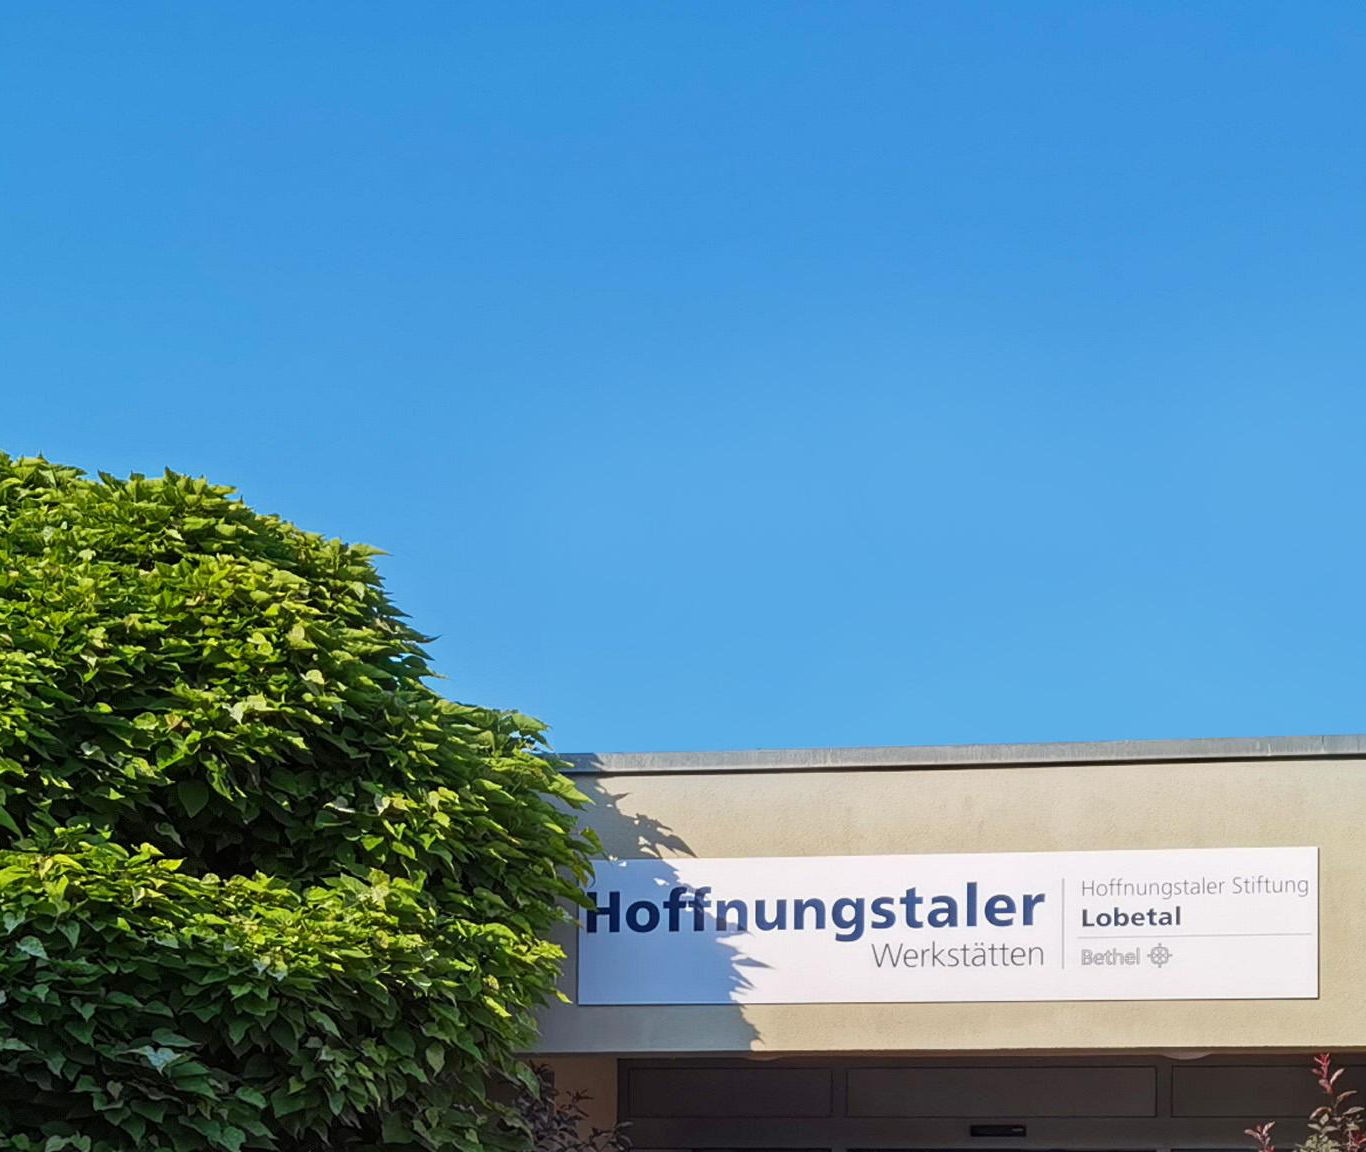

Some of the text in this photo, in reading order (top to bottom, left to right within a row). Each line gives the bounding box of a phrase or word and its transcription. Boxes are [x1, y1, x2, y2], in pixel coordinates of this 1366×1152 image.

[1081, 875, 1310, 900] Hoffnungstaler Stiftung
[585, 882, 1046, 942] Hoffnungstaler
[1081, 906, 1181, 927] Lobetal
[871, 941, 1045, 969] Werkstätten
[1080, 947, 1141, 966] Bethel
